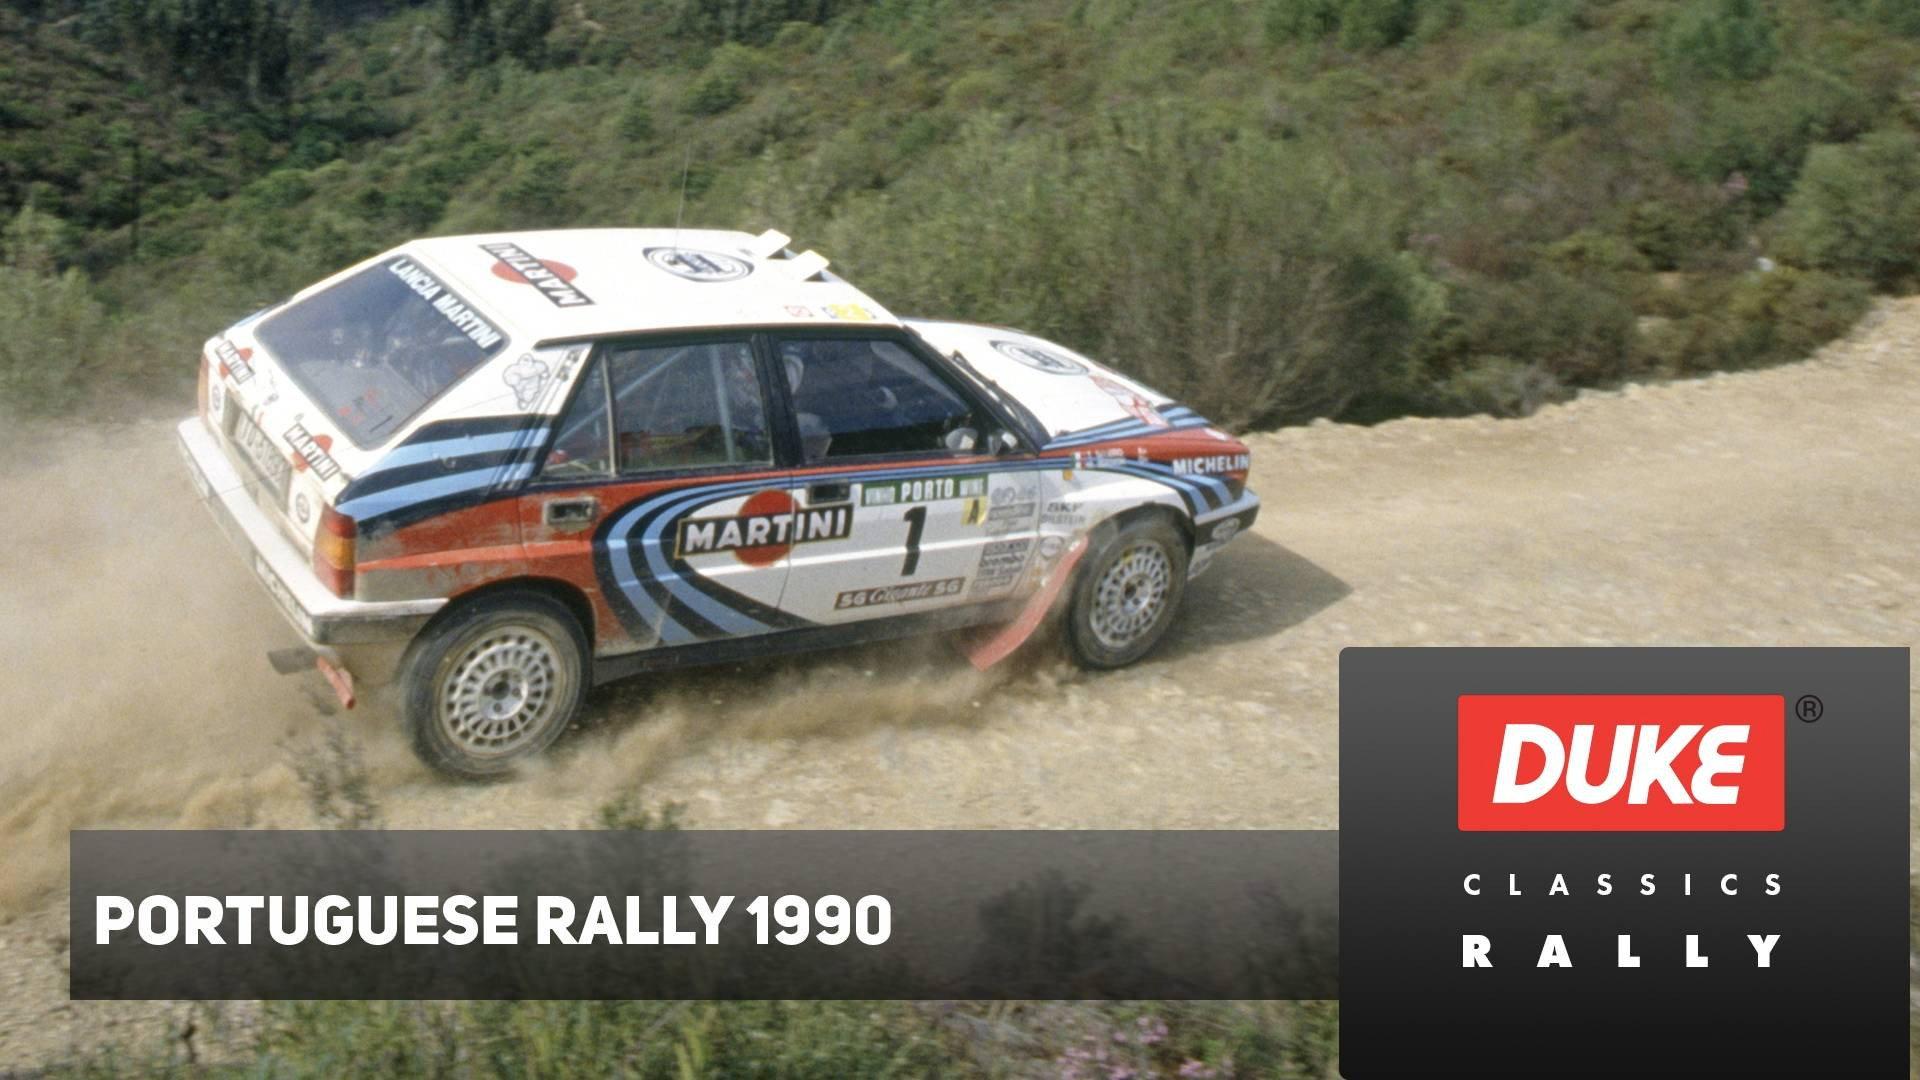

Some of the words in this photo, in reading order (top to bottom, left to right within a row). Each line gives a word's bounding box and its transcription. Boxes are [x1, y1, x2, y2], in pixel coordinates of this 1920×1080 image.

[482, 242, 587, 307] MARTINI
[388, 257, 435, 302] LANCIA
[431, 292, 503, 349] MARTINI
[284, 424, 339, 480] MARTINI
[1172, 453, 1249, 475] MICHELIN
[900, 478, 955, 503] PORTO
[1046, 502, 1085, 513] SKF
[685, 508, 846, 552] MARTINI
[966, 499, 979, 525] A
[900, 506, 928, 576] 1
[839, 591, 867, 608] SG
[933, 579, 961, 596] SG
